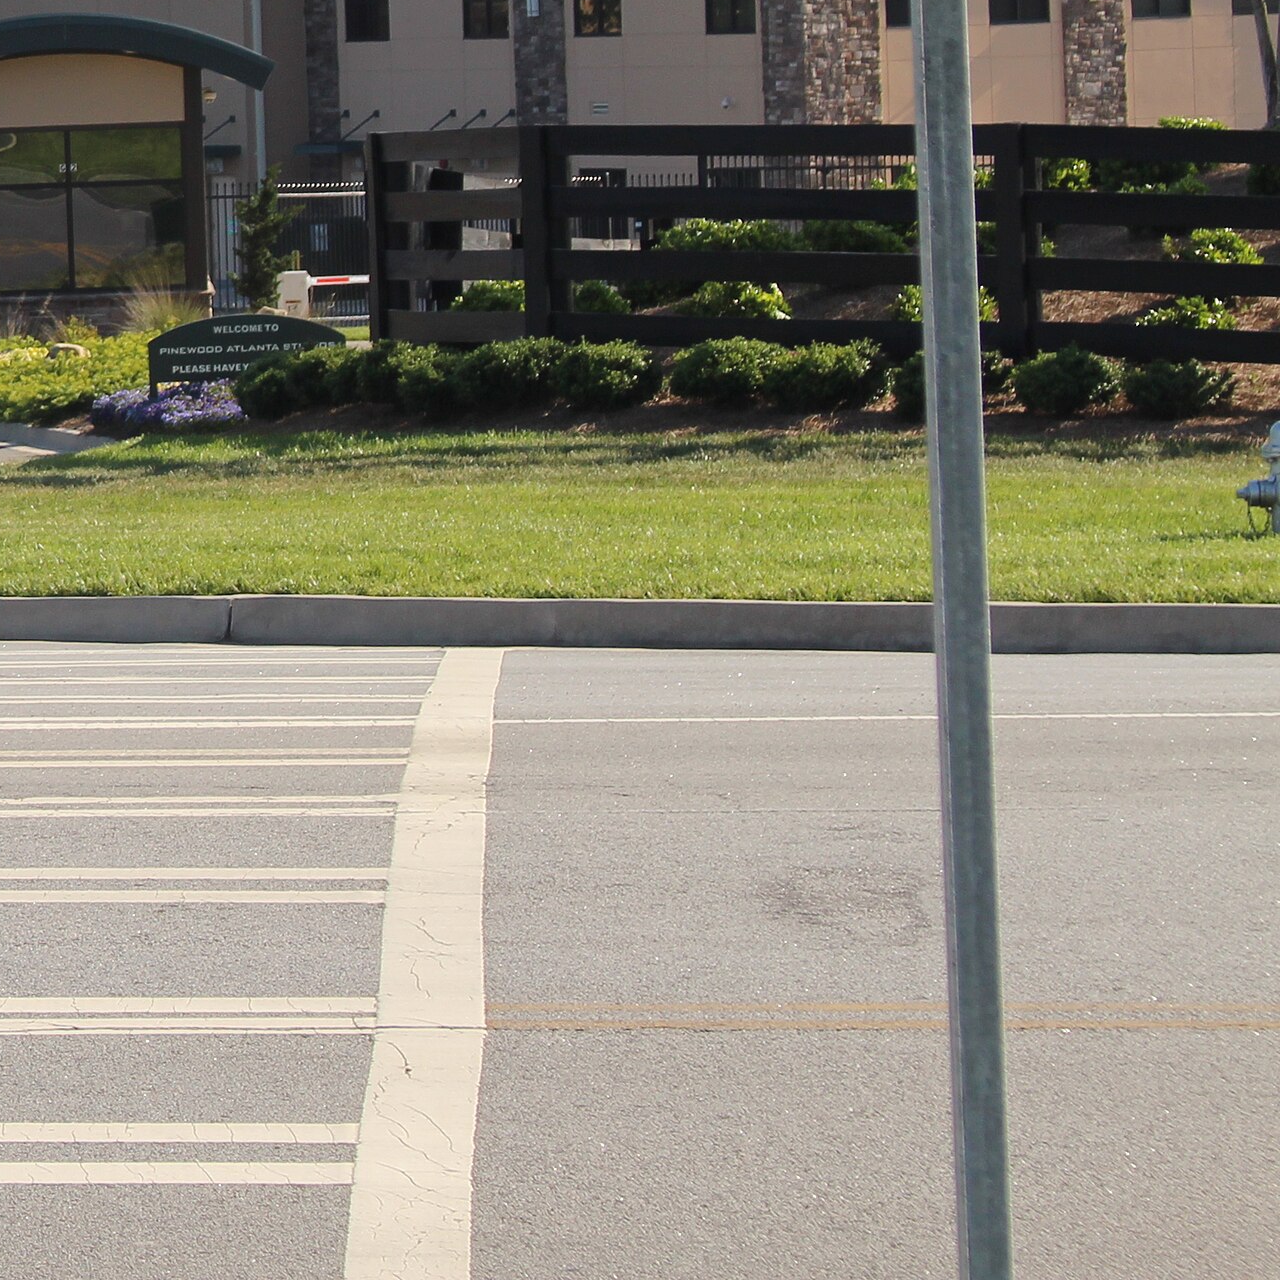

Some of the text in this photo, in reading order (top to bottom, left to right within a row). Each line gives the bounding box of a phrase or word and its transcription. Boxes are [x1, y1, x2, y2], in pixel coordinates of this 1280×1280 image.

[213, 323, 279, 334] WELCOME TO
[159, 345, 223, 356] PINEWOOD
[226, 343, 280, 354] ATLANTA
[172, 364, 211, 374] PLEASE
[213, 363, 241, 372] HAVE
